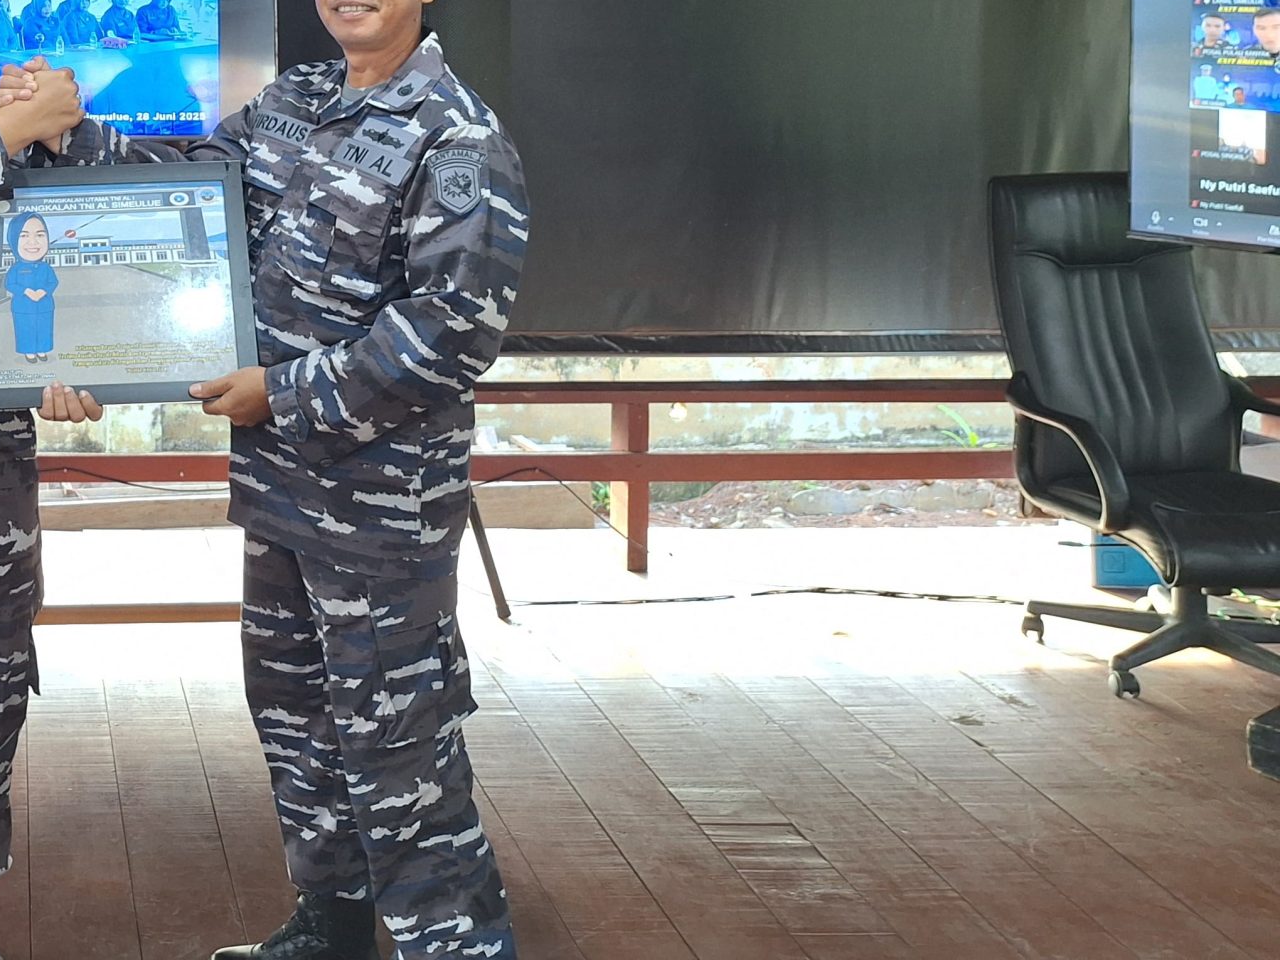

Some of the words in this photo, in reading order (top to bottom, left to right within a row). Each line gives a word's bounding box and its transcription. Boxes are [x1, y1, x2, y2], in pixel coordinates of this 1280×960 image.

[83, 111, 133, 122] imeulue,
[136, 112, 150, 121] 28
[153, 112, 176, 121] Juni
[179, 112, 206, 121] 2025
[254, 113, 309, 143] IRDAUS
[342, 143, 370, 165] TNI
[368, 155, 394, 178] AL
[1200, 179, 1217, 192] Ny
[1218, 180, 1246, 193] Putri
[18, 203, 77, 213] PANGKALAN
[79, 202, 96, 211] TNI
[97, 201, 110, 210] AL
[111, 199, 162, 210] SIMEULUE
